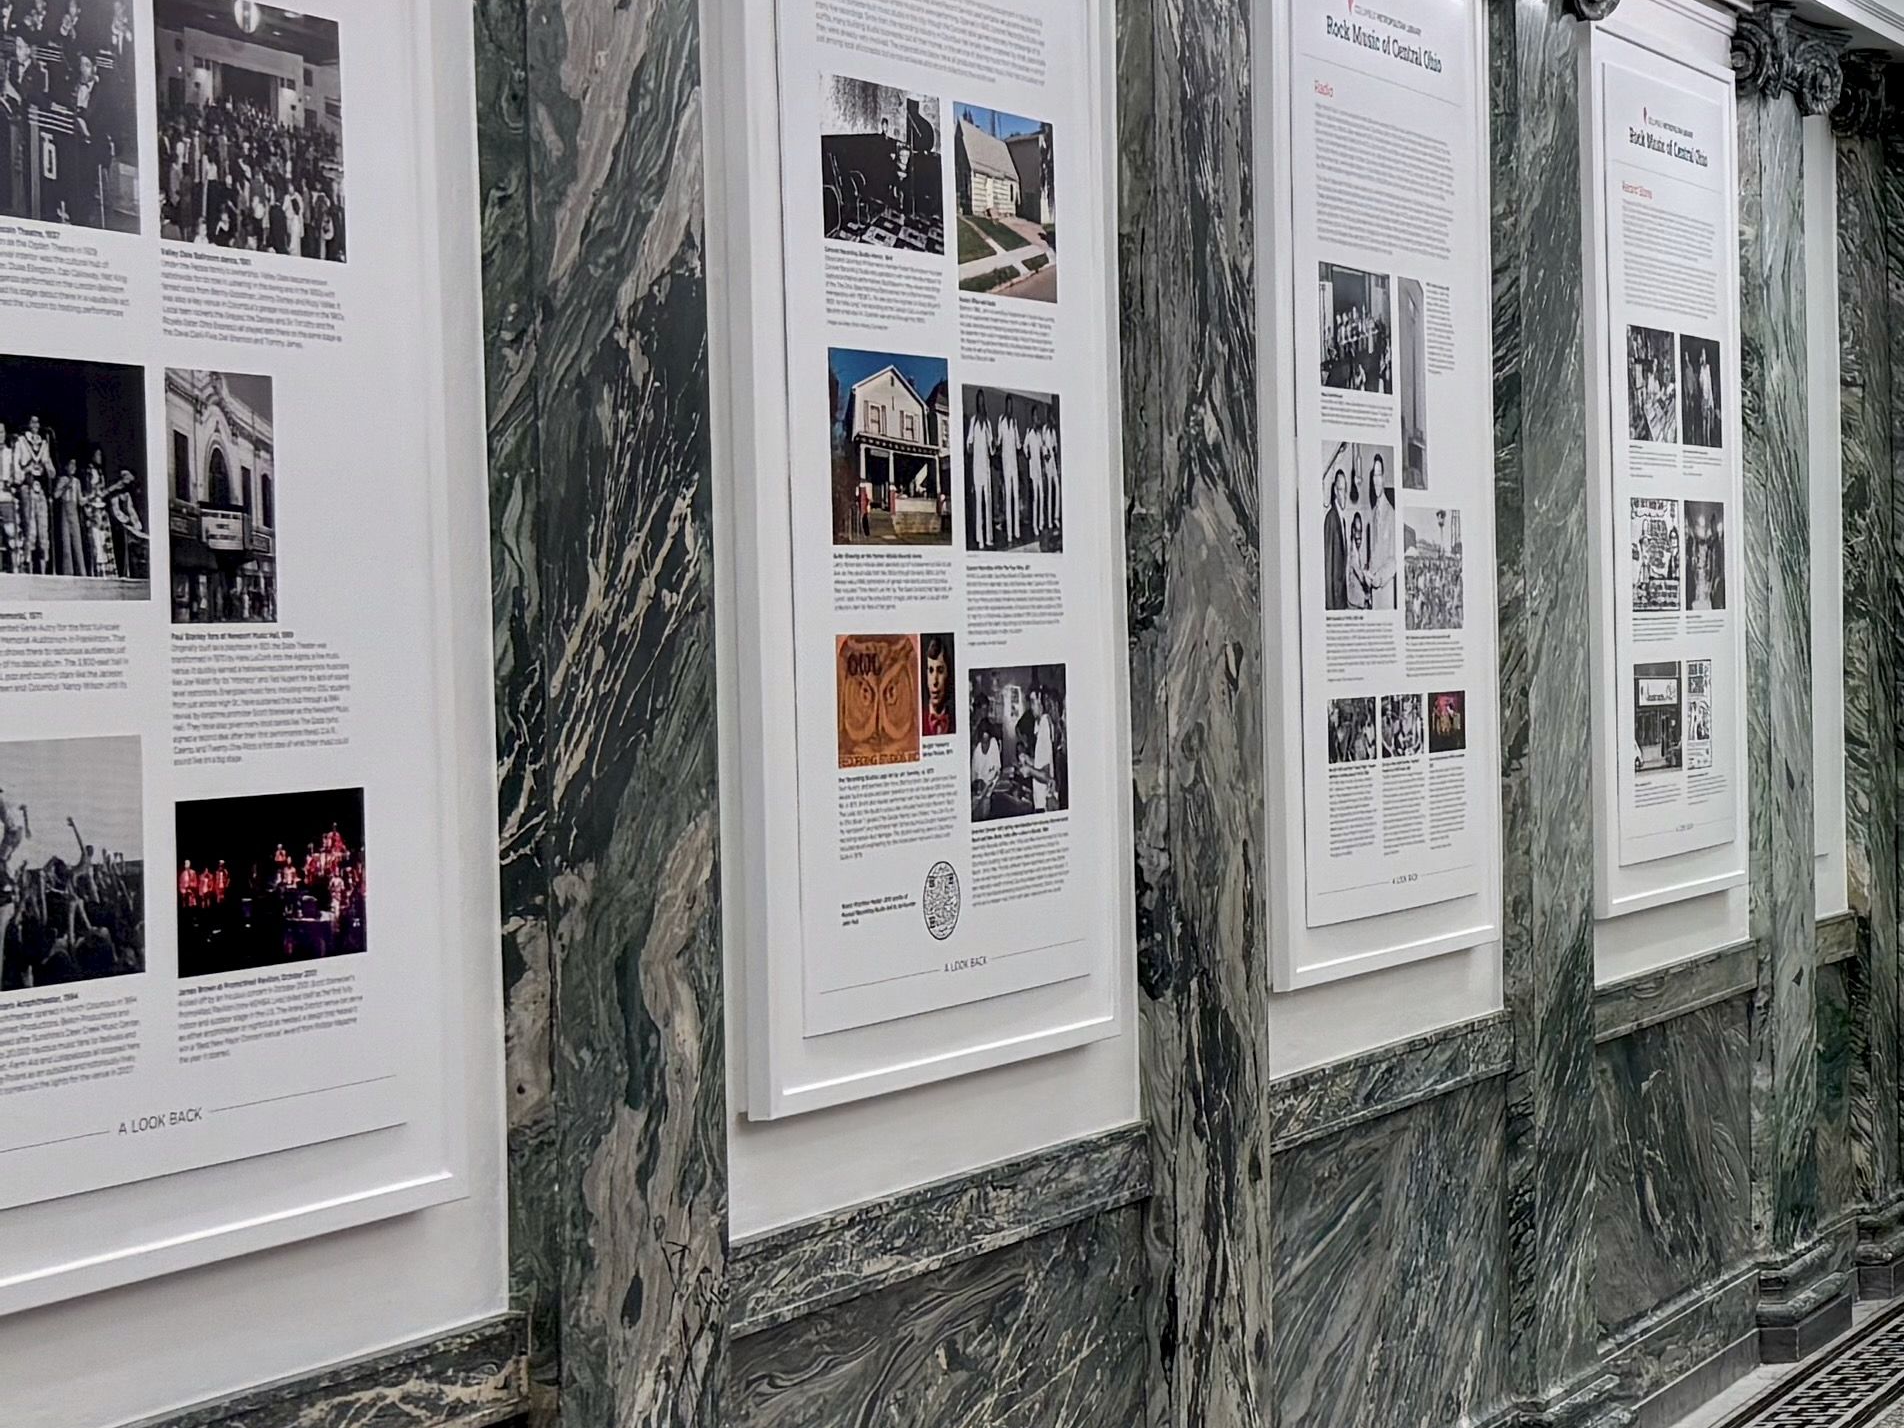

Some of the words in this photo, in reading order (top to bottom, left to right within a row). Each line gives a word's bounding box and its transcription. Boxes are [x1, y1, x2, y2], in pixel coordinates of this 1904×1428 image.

[1326, 14, 1350, 42] Rock
[1352, 23, 1380, 51] Music
[1381, 35, 1391, 55] of
[1392, 38, 1422, 67] Central
[1424, 50, 1442, 74] Ohio
[119, 1123, 127, 1135] A
[132, 1114, 165, 1133] LOOK
[170, 1107, 202, 1125] BACK
